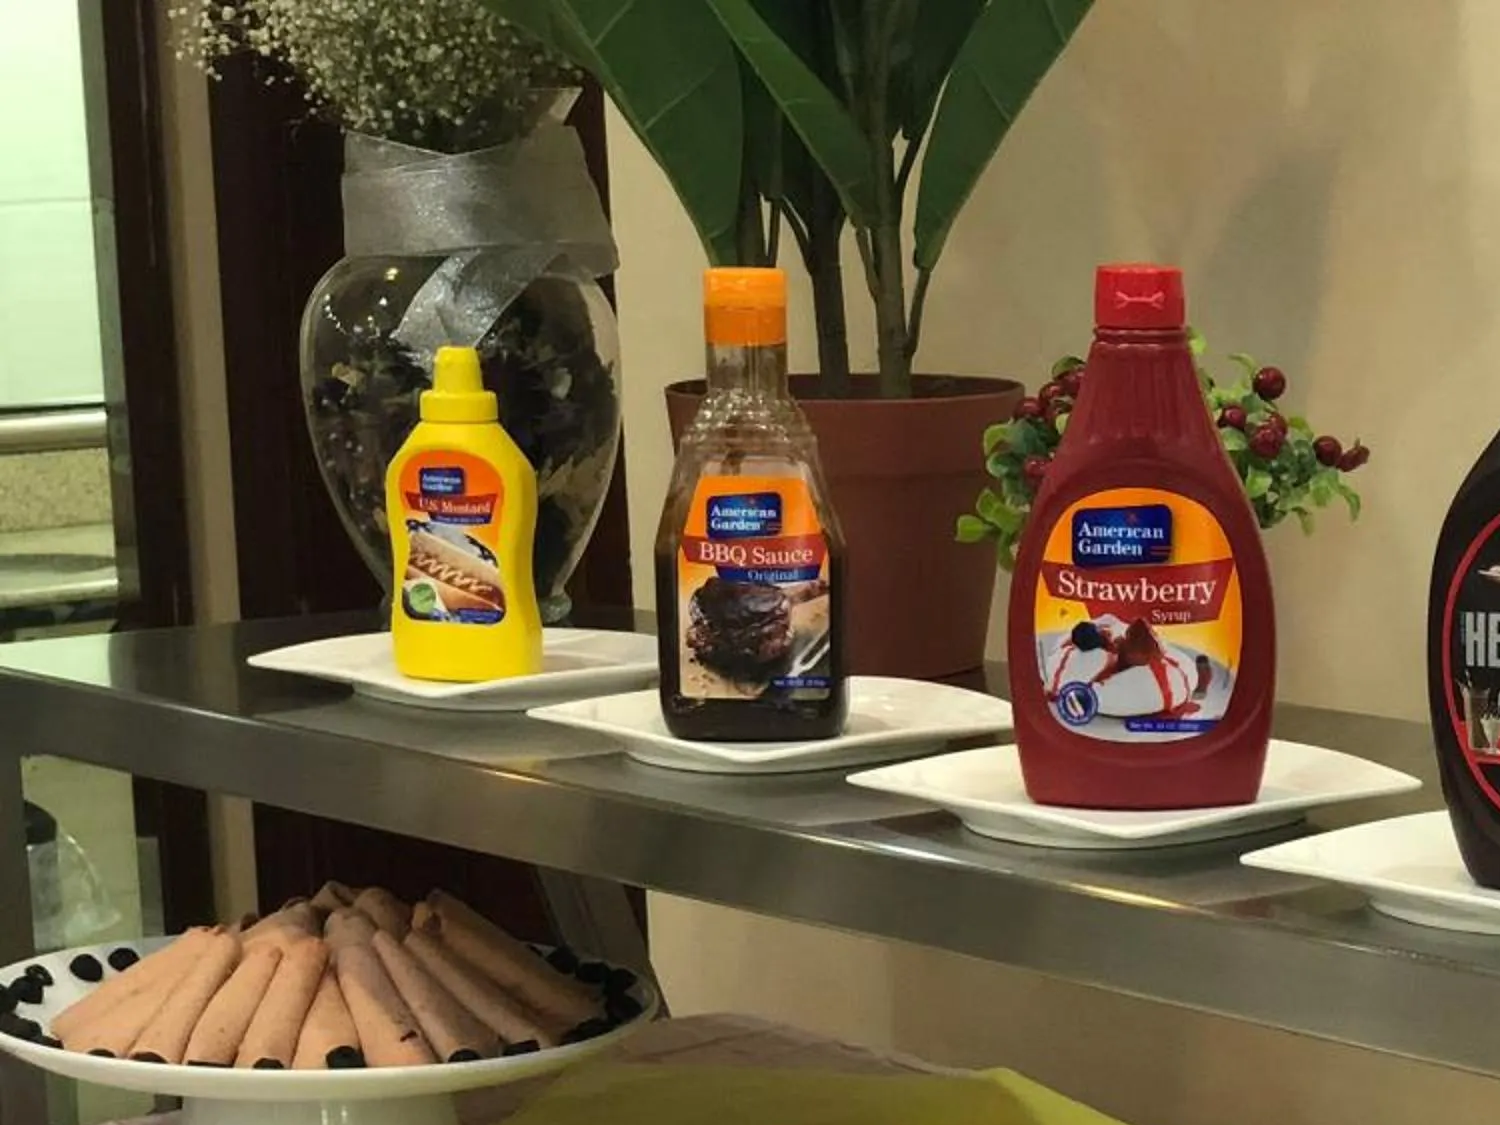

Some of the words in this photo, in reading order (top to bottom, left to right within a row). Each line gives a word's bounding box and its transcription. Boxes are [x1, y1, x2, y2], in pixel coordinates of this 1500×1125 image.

[441, 500, 491, 514] Mustard
[710, 506, 777, 519] American
[710, 518, 762, 531] Garden
[1078, 521, 1165, 540] American
[699, 542, 747, 567] BBQ
[751, 546, 814, 565] Sauce
[1078, 540, 1143, 557] Garden
[747, 568, 800, 583] Original
[1058, 569, 1218, 605] Strawberry
[1151, 608, 1192, 624] Syrup
